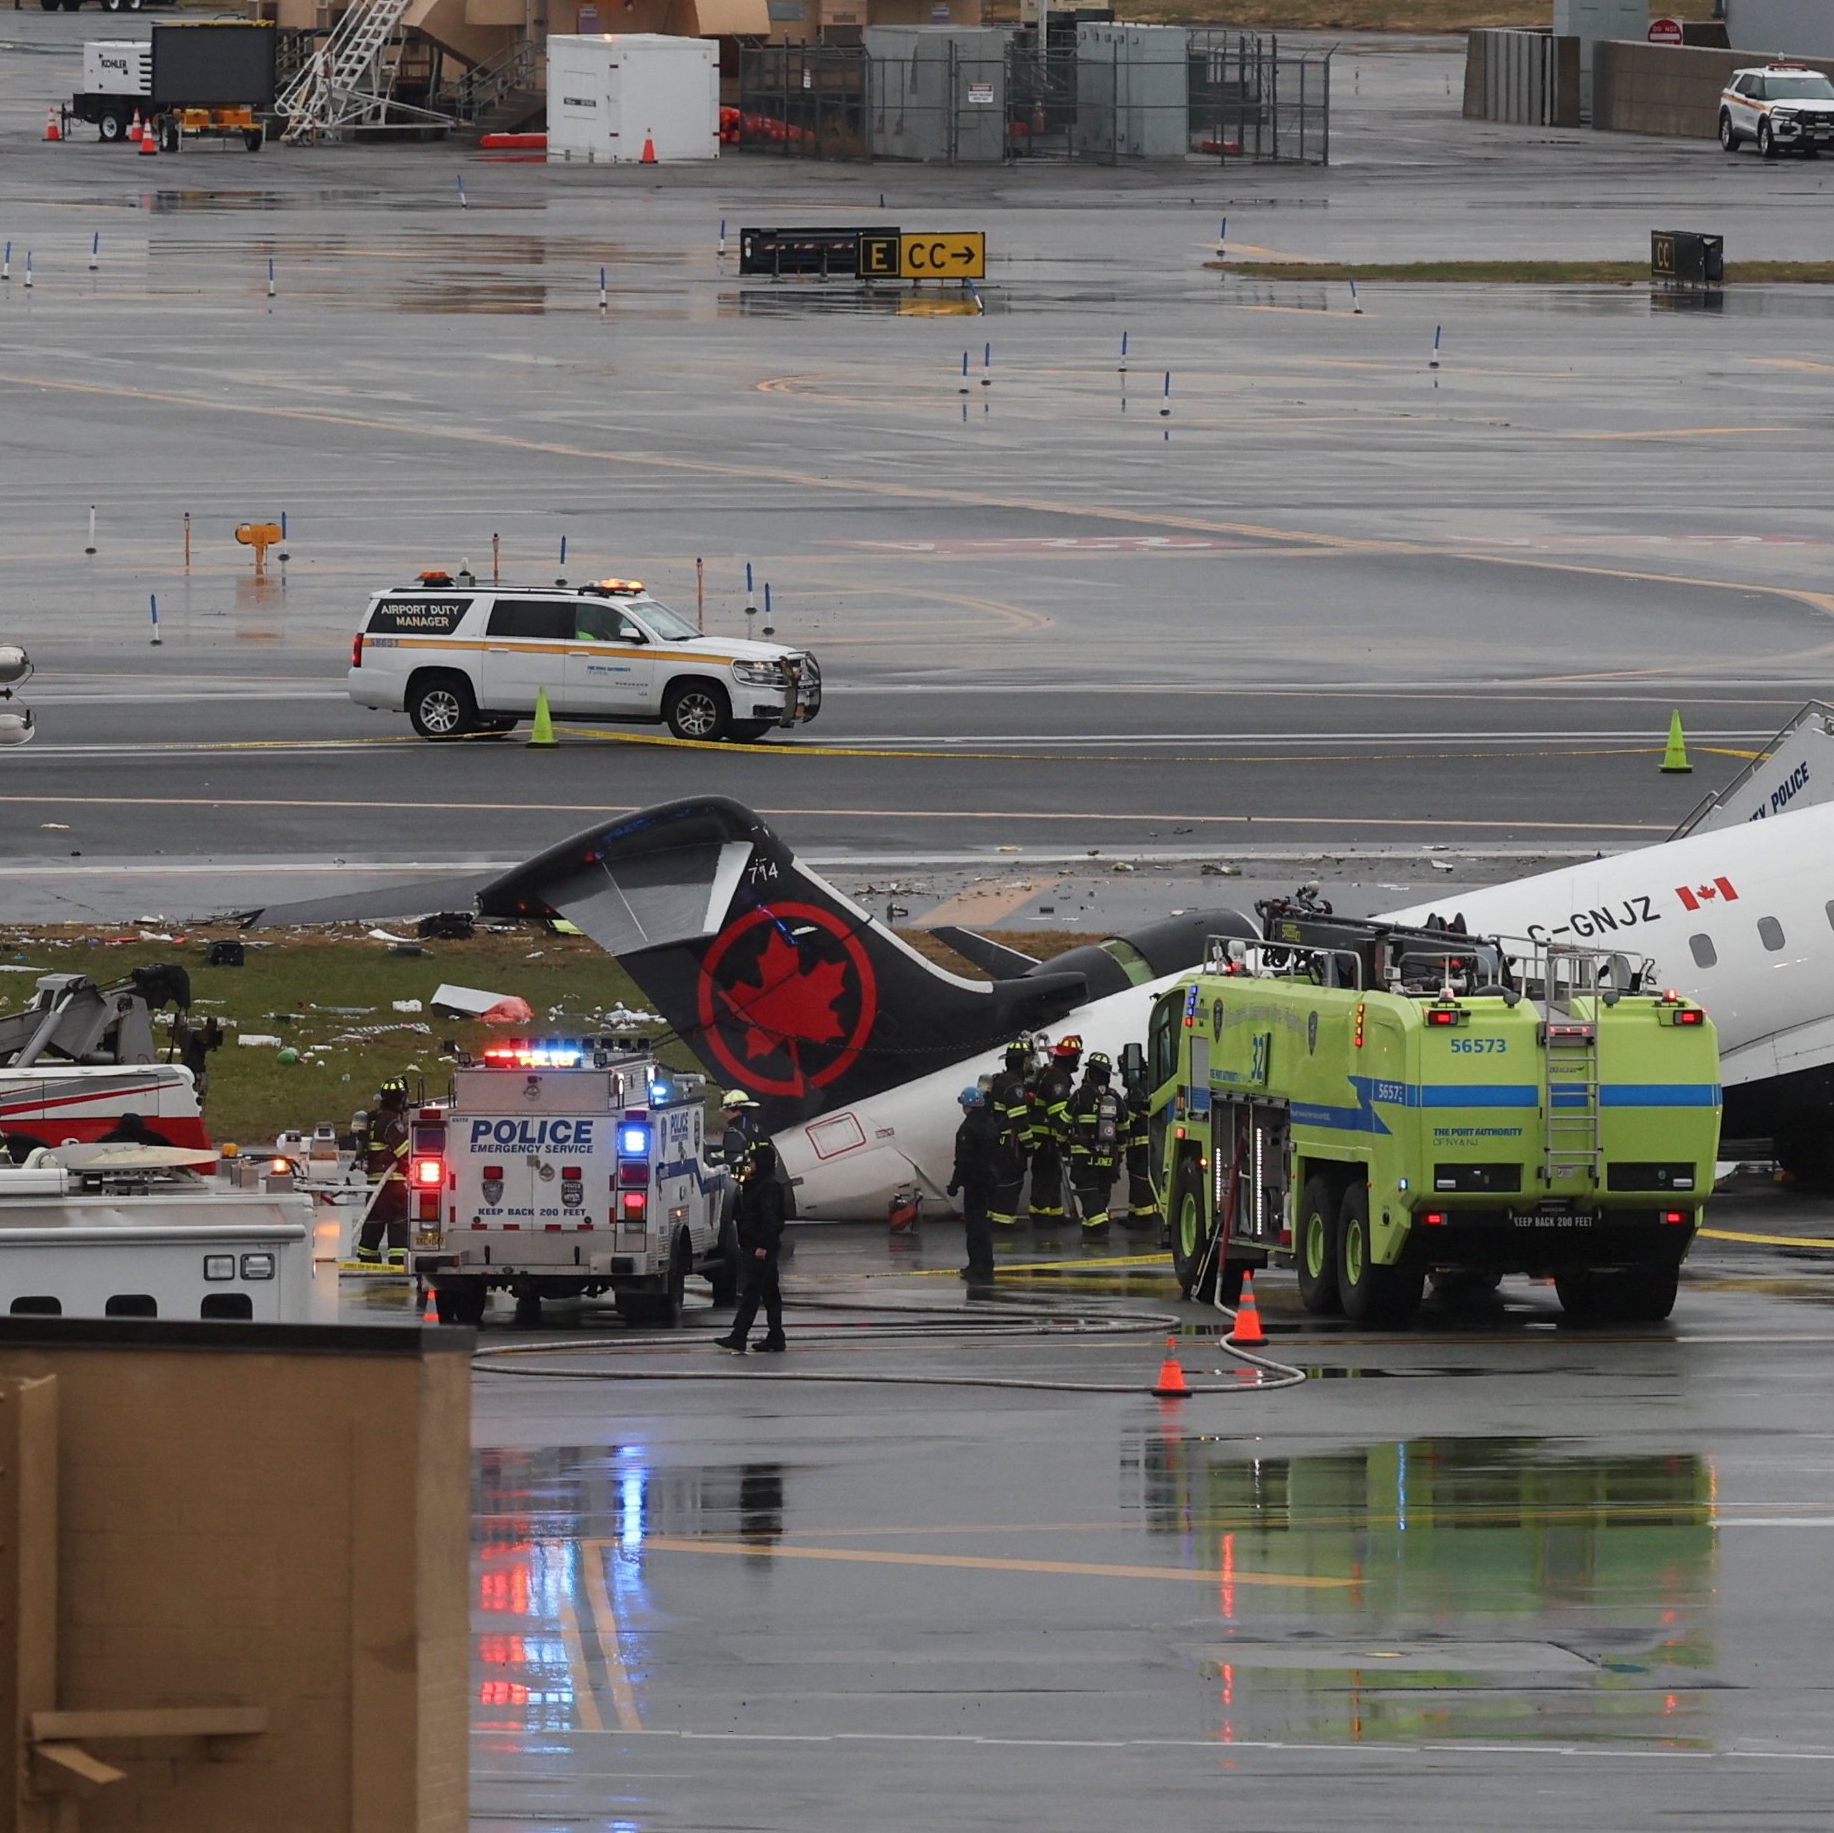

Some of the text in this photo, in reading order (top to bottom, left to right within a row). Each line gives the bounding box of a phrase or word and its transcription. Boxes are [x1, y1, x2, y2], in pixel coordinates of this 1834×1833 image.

[101, 59, 127, 69] KOHLER
[871, 243, 946, 270] E CC
[380, 604, 460, 616] AIRPORT DUTY
[396, 616, 450, 627] MANAGER
[1770, 760, 1810, 815] POLICE
[747, 861, 779, 885] 714
[1527, 895, 1662, 948] C-GNJZ
[1450, 1038, 1507, 1054] 56573
[1251, 1035, 1266, 1081] 32
[470, 1119, 595, 1145] POLICE
[1433, 1128, 1523, 1136] THE PORT AUTHORITY
[1432, 1138, 1446, 1147] OF
[470, 1144, 594, 1154] EMERGENCY SERVICE
[478, 1208, 586, 1216] KEEP BACK 200 FEET
[1535, 1216, 1555, 1227] BACK
[1557, 1216, 1573, 1227] 200
[1575, 1216, 1593, 1227] FEET
